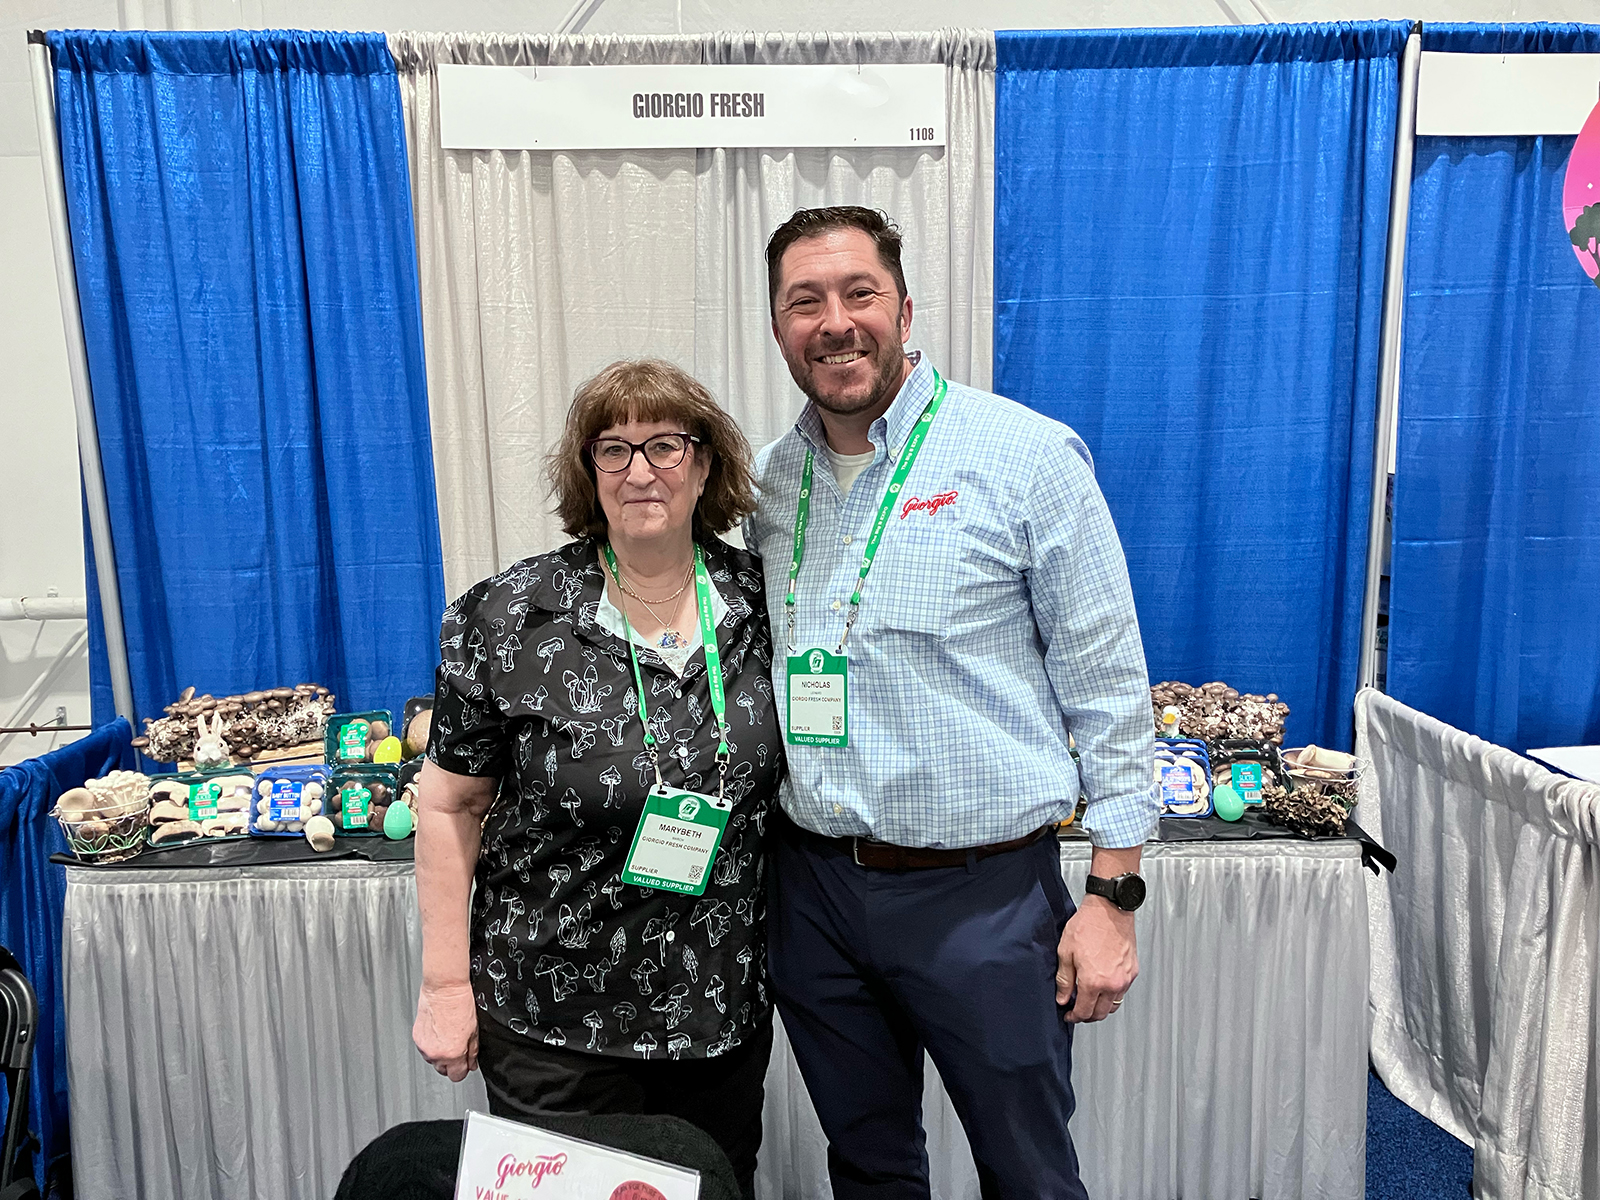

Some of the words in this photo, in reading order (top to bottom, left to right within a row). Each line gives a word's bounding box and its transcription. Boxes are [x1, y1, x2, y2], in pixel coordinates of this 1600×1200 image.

[633, 93, 704, 118] GIORGIO
[710, 93, 765, 118] FRESH
[909, 127, 934, 141] 1108
[911, 434, 920, 448] EXPO
[880, 506, 888, 520] EXPO
[801, 681, 831, 689] NICHOLAS
[815, 737, 841, 745] SUPPLIER
[659, 823, 703, 839] MARYBETH
[641, 836, 665, 845] GIORGIO
[665, 840, 683, 849] FRESH
[683, 844, 709, 854] COMPANY
[631, 864, 659, 874] SUPPLIER
[633, 875, 661, 886] VALUED
[661, 880, 695, 892] SUPPLIER
[495, 1152, 568, 1190] Giorgio
